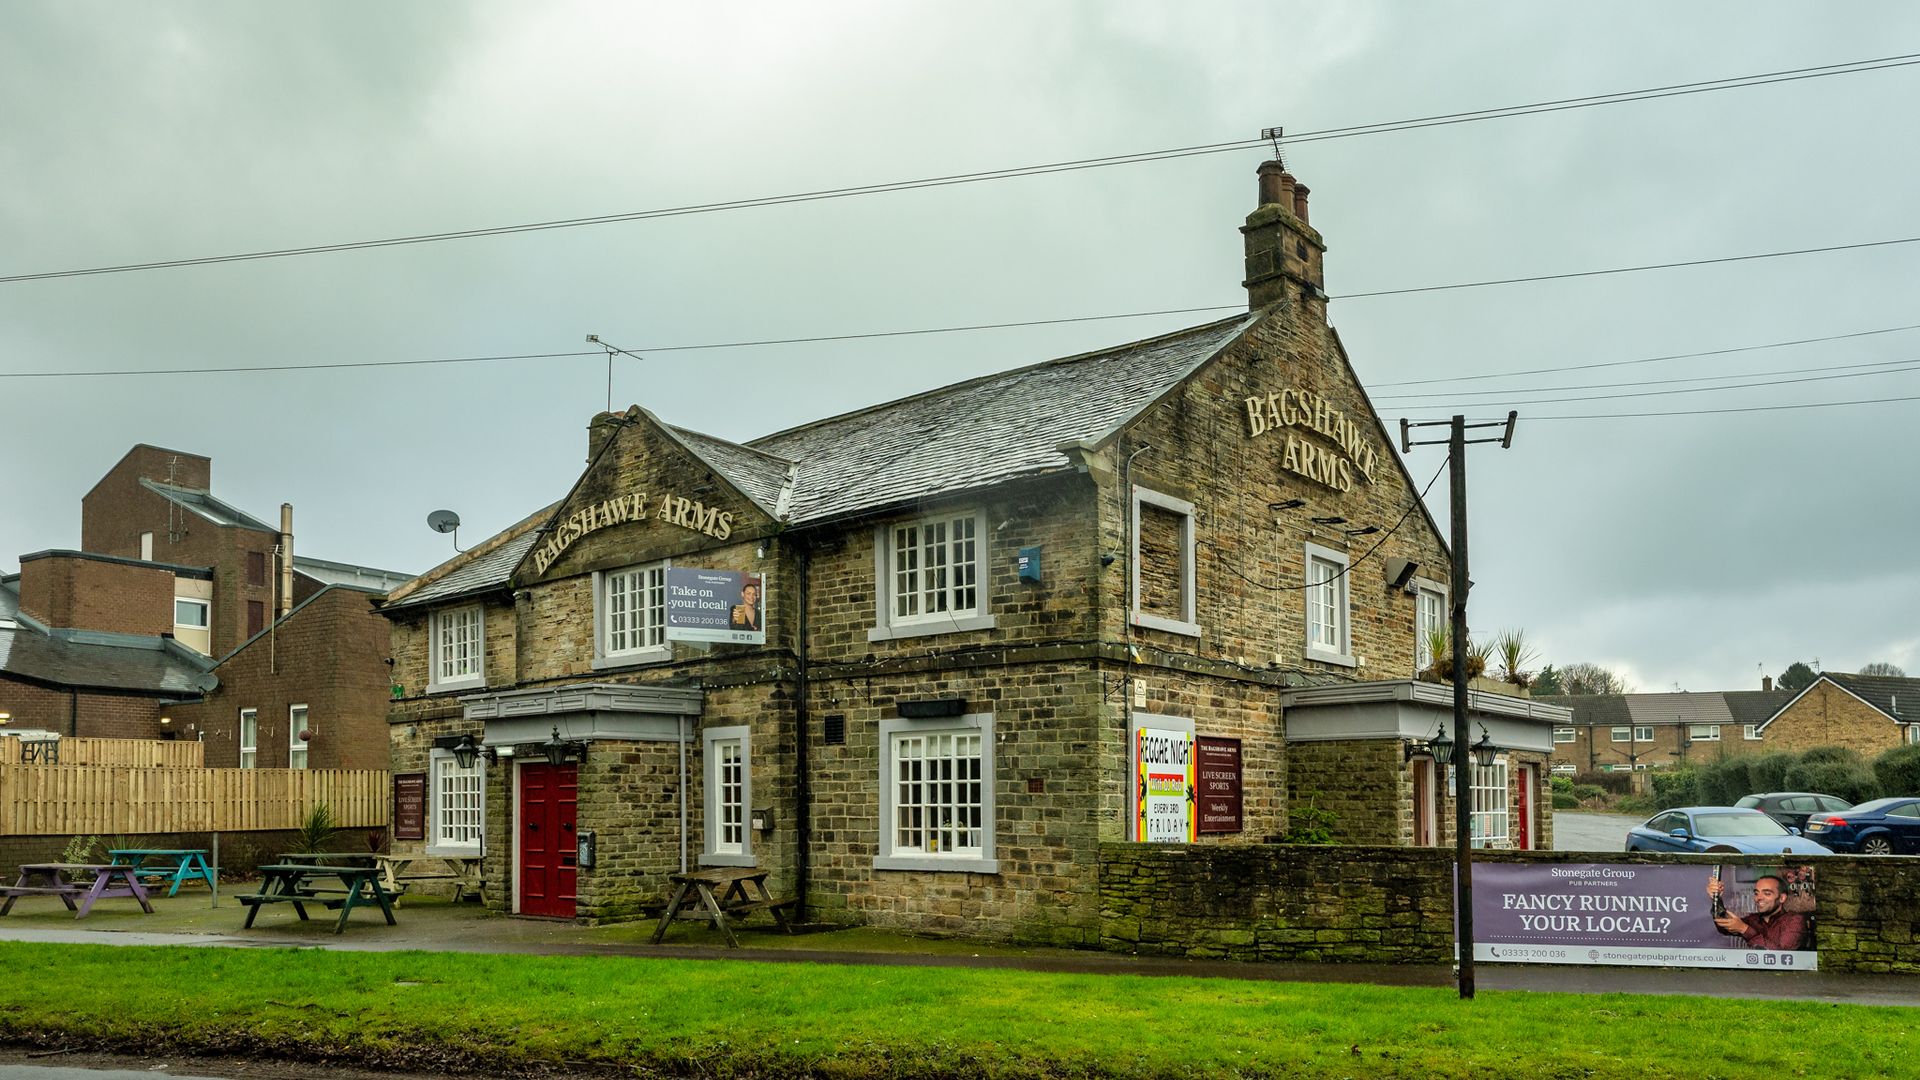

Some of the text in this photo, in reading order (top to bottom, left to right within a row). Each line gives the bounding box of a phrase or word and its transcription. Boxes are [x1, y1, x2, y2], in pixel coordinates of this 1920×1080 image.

[1244, 388, 1379, 485] BAGSHAWE
[1281, 435, 1351, 493] ARMS
[533, 492, 733, 576] BAGSHAWE ARMS
[671, 586, 713, 598] Take on
[671, 598, 728, 610] your local!
[678, 616, 700, 624] 03333
[701, 617, 714, 625] 200
[1140, 736, 1194, 765] REGGAE NIGHT
[1202, 771, 1237, 781] LIVE SCREEN
[1209, 782, 1230, 790] SPORTS
[1154, 803, 1179, 814] EVERY 3RD
[1211, 803, 1229, 814] Weekly
[1204, 814, 1236, 823] Entertainment
[1551, 867, 1635, 880] Stonegate Group
[1502, 893, 1688, 913] FANCY RUNNING
[1519, 914, 1671, 934] YOUR LOCAL?
[1502, 948, 1566, 959] 03333 200 036
[1602, 951, 1727, 963] stonegatepubpartners.co.uk
